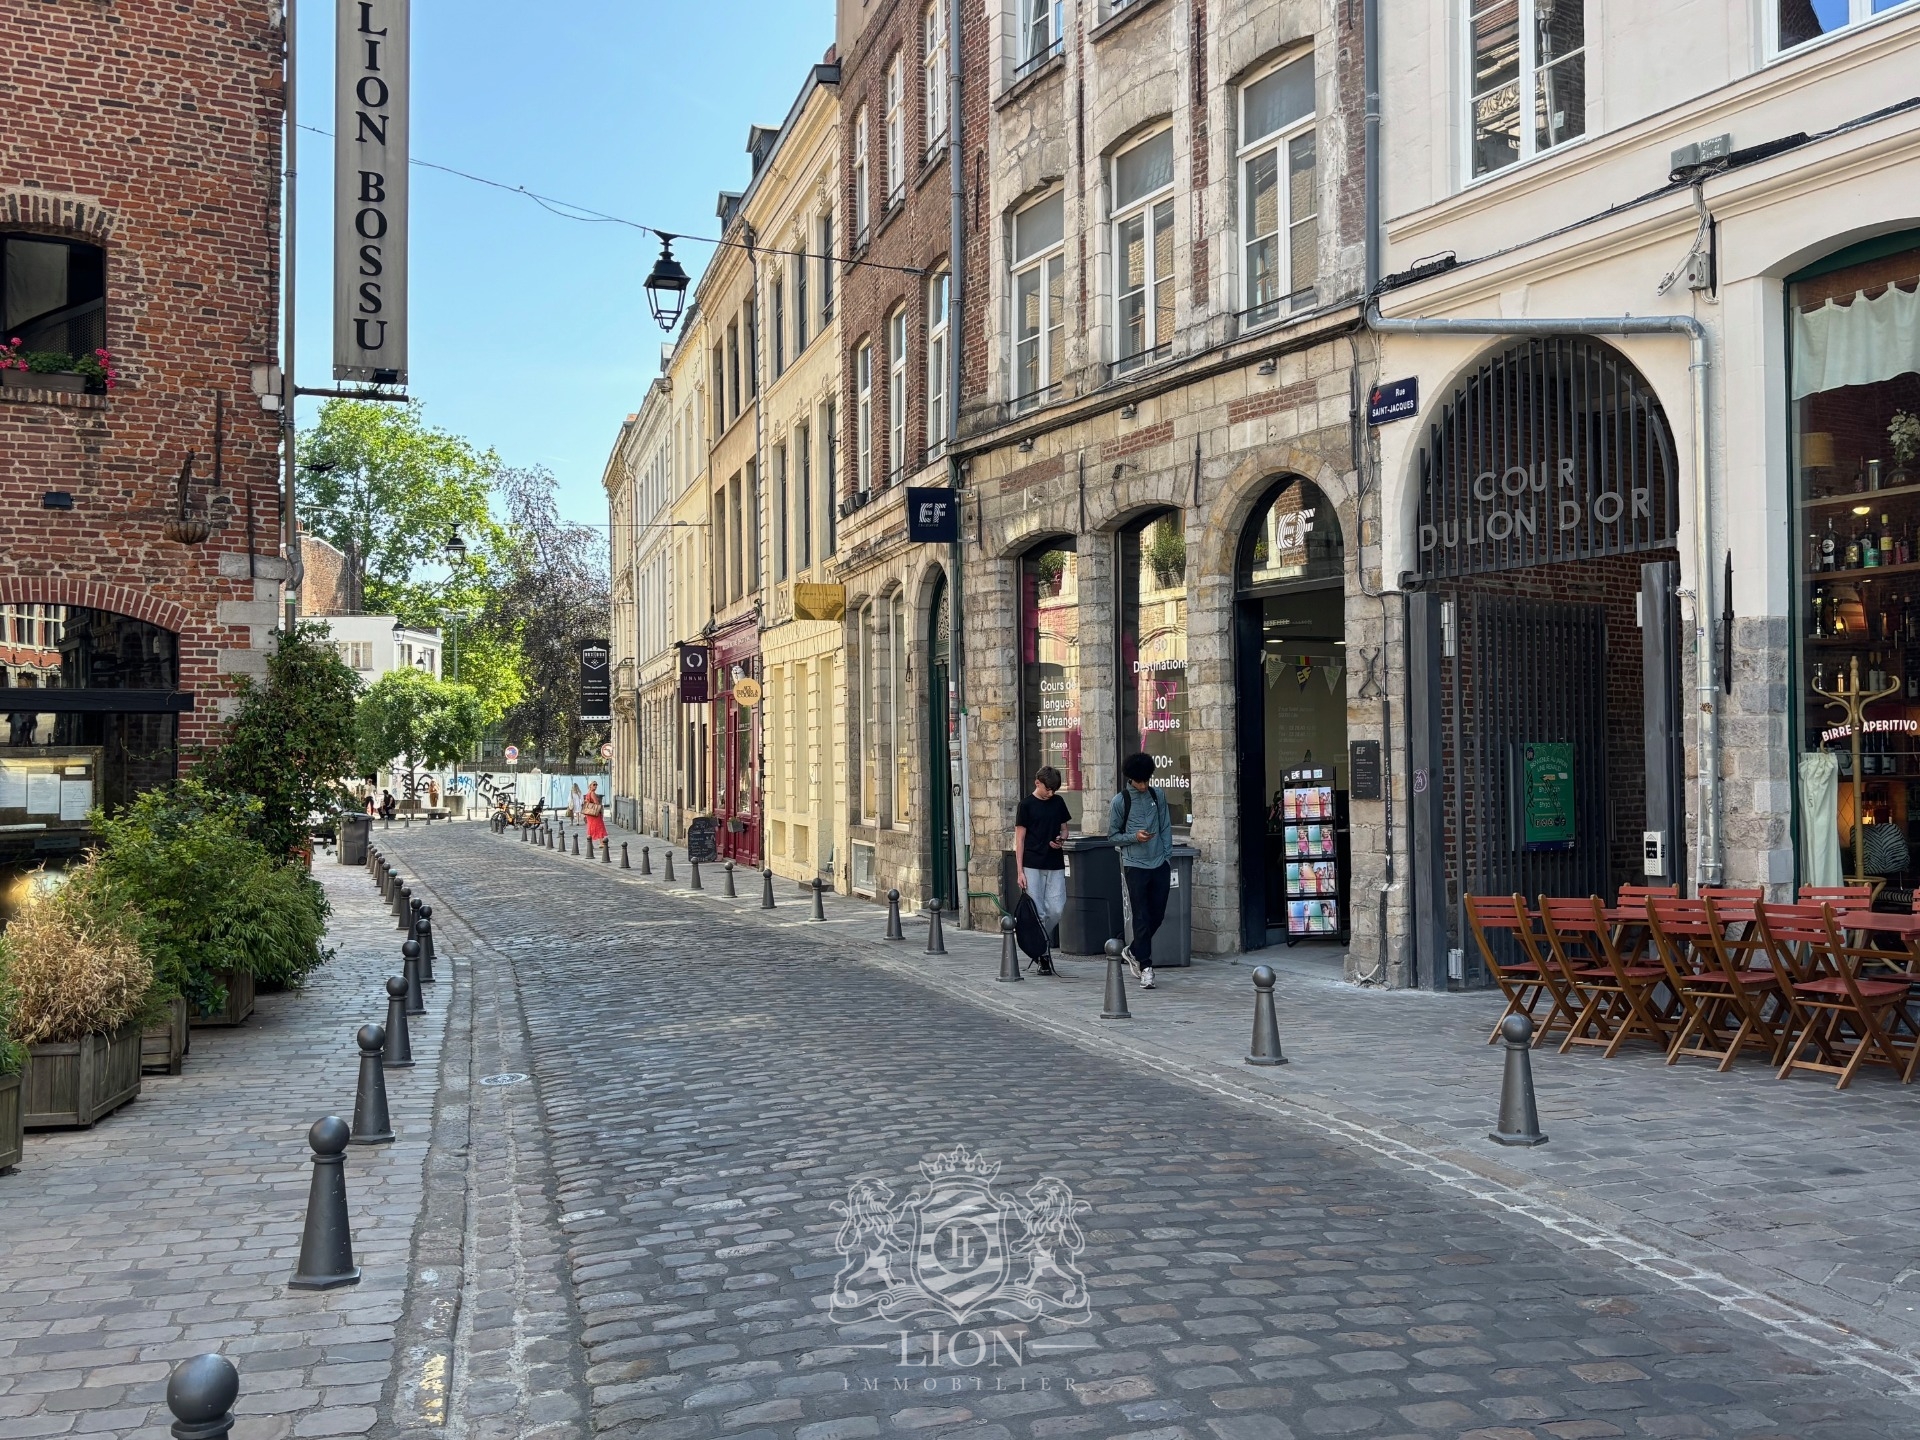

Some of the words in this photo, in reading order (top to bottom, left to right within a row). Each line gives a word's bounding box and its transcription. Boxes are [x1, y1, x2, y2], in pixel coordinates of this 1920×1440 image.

[355, 2, 389, 147] LION
[355, 169, 389, 351] BOSSU
[1395, 388, 1406, 397] Rue
[1372, 399, 1414, 417] SAINT-JACQUES
[1473, 458, 1575, 501] COUR
[919, 502, 947, 523] EF
[1419, 518, 1459, 552] DU
[1466, 506, 1537, 545] LION
[1559, 487, 1651, 531] D'OR
[1133, 658, 1189, 674] Destinations
[1040, 680, 1065, 692] Cours
[1043, 697, 1075, 712] langues
[1155, 697, 1167, 710] 10
[1036, 716, 1042, 727] à
[1143, 716, 1181, 732] Langues
[1821, 724, 1852, 742] BIRRE
[1862, 719, 1918, 733] APERITIVO
[1356, 746, 1366, 754] EF
